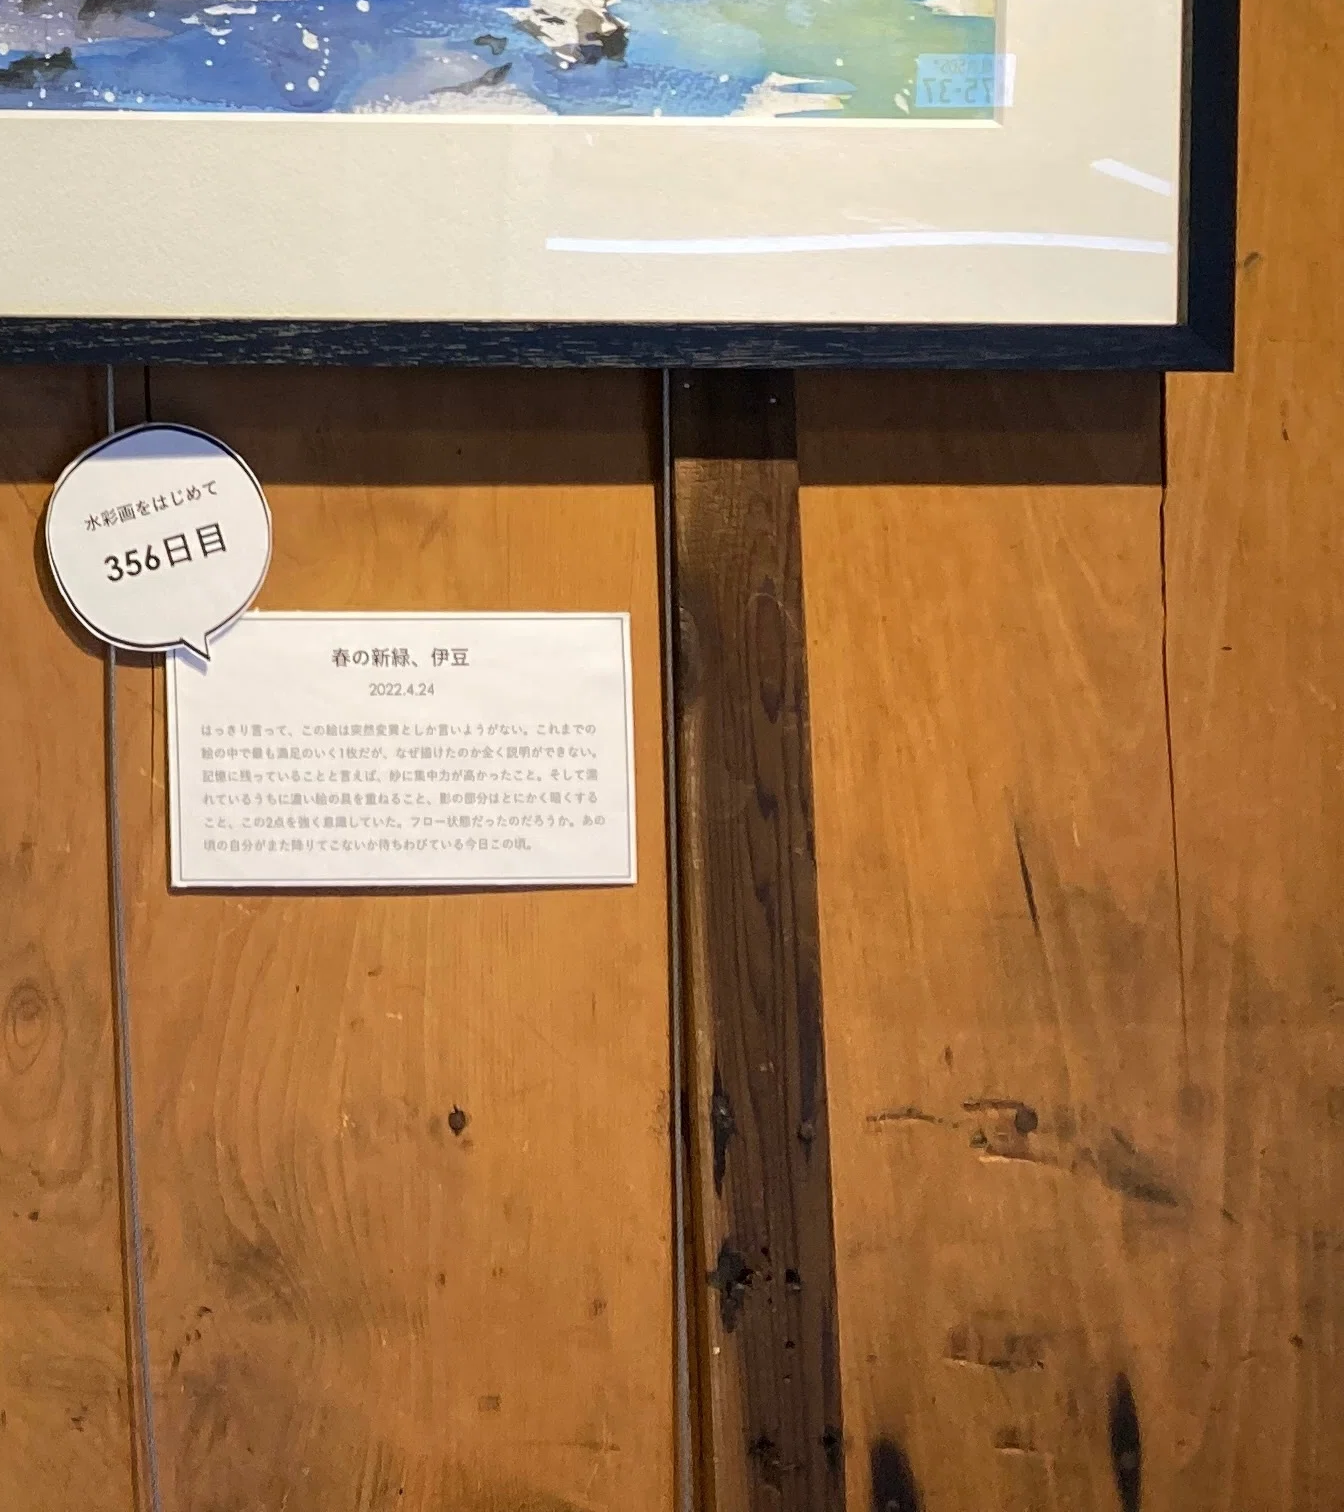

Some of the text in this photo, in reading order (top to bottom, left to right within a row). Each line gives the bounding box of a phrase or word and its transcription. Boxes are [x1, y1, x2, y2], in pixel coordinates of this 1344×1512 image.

[84, 479, 219, 532] 水彩画をはじめて
[103, 522, 227, 583] 356日目
[331, 647, 470, 668] 春の新緑、伊豆
[368, 682, 435, 697] 2022.4.24
